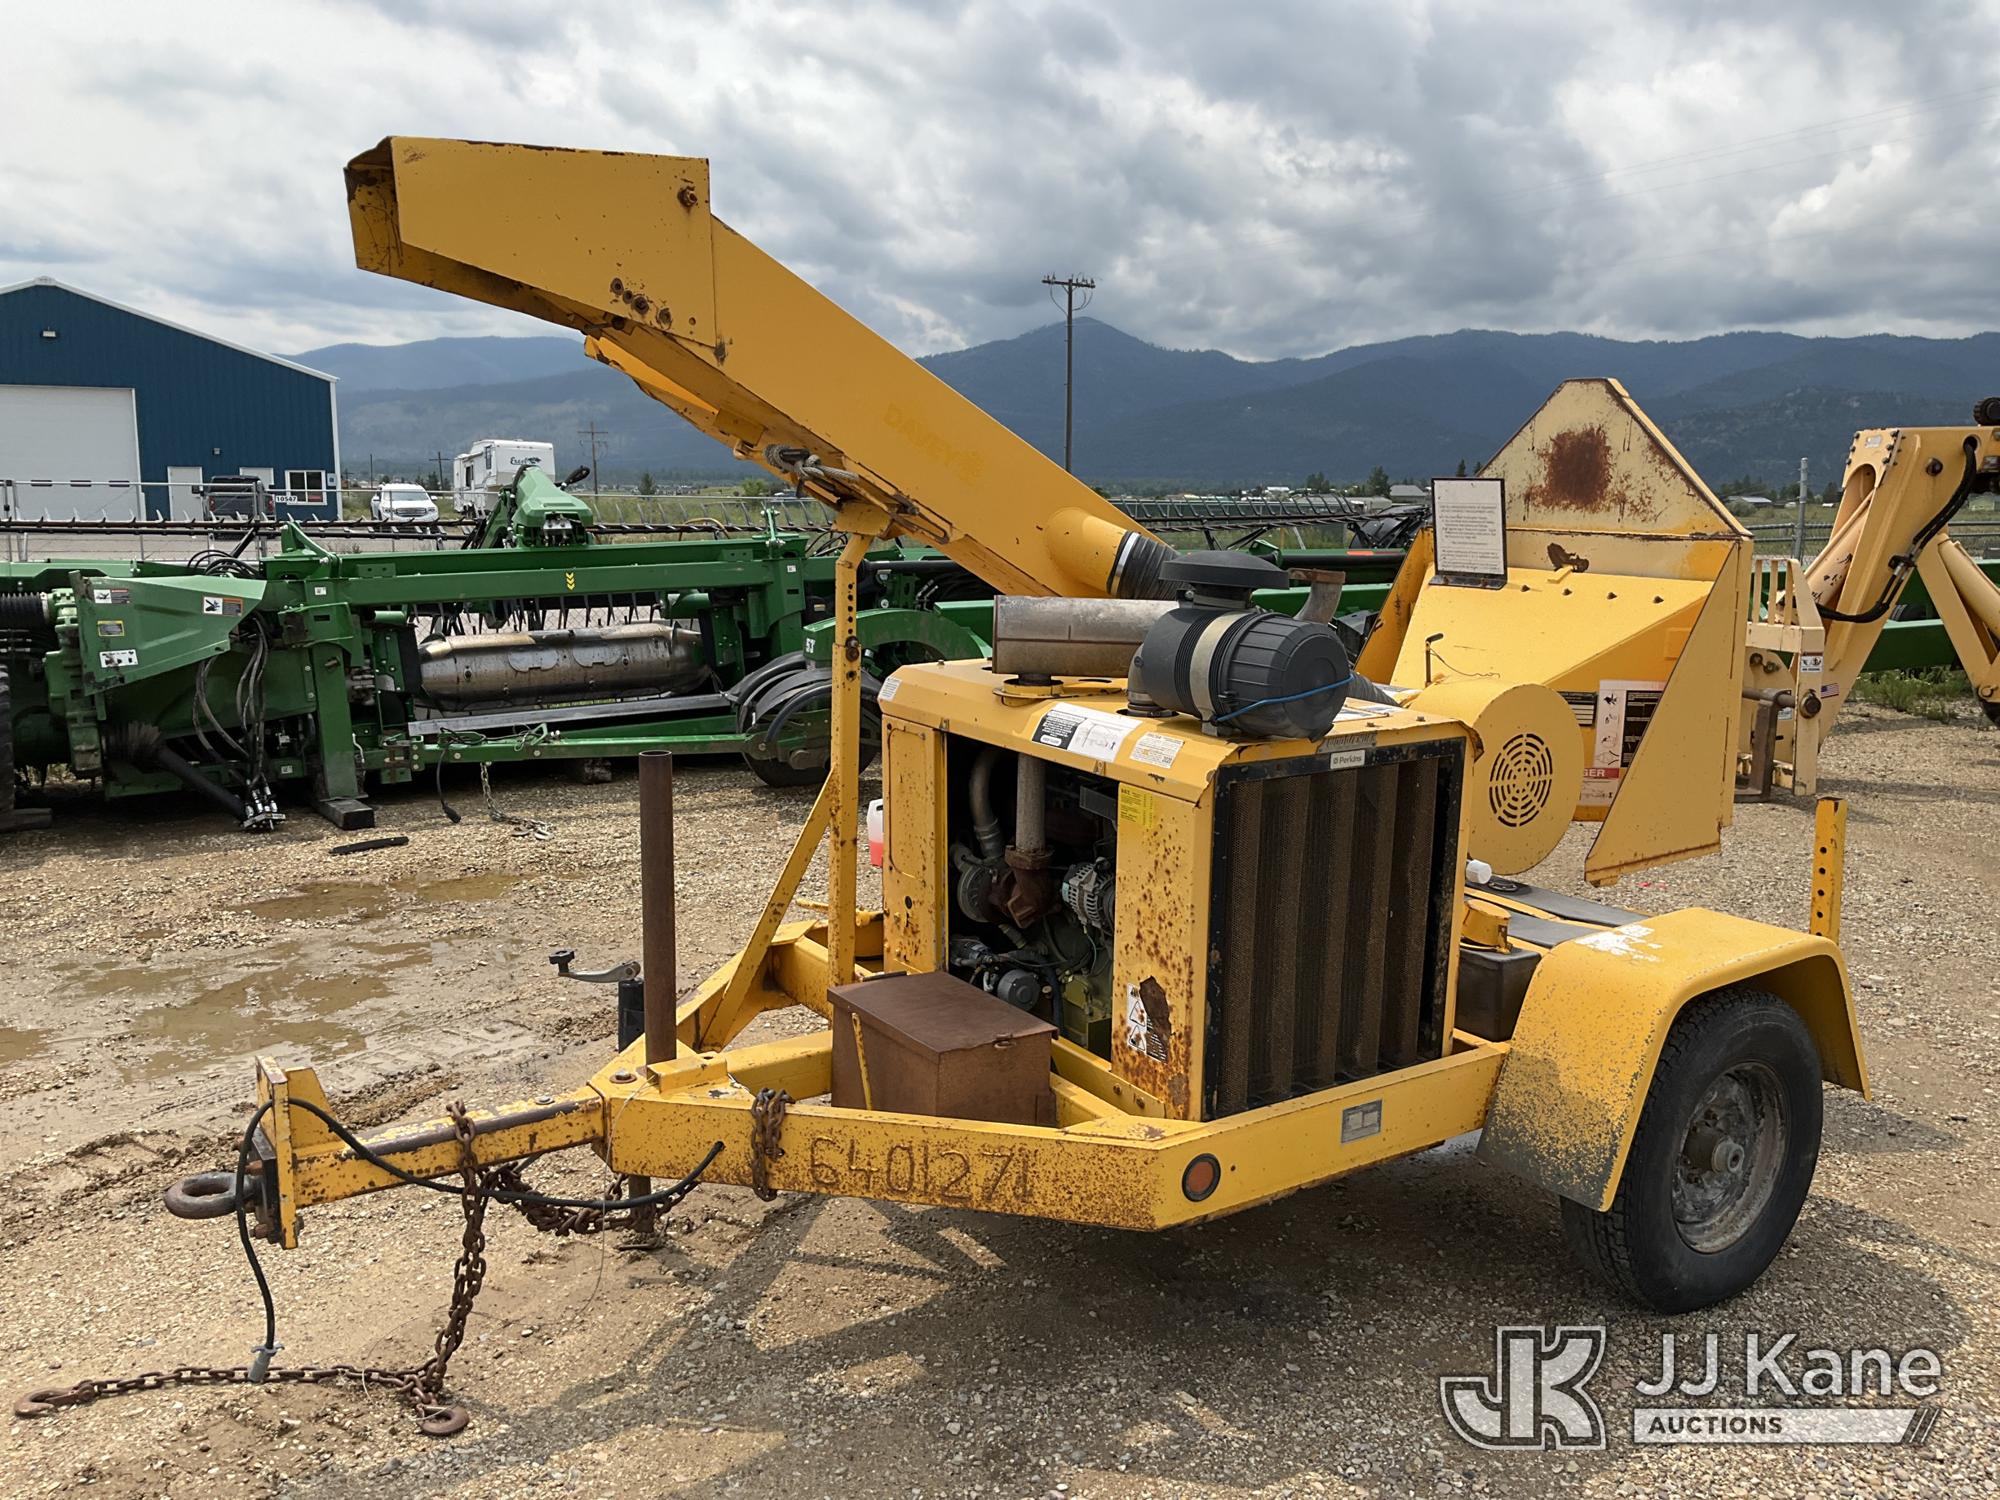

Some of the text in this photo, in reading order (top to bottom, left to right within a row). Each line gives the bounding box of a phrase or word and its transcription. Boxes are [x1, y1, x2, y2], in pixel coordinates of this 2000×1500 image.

[1340, 754, 1362, 764] Perkins
[1584, 768, 1606, 777] GER
[810, 1136, 1032, 1201] 6401271
